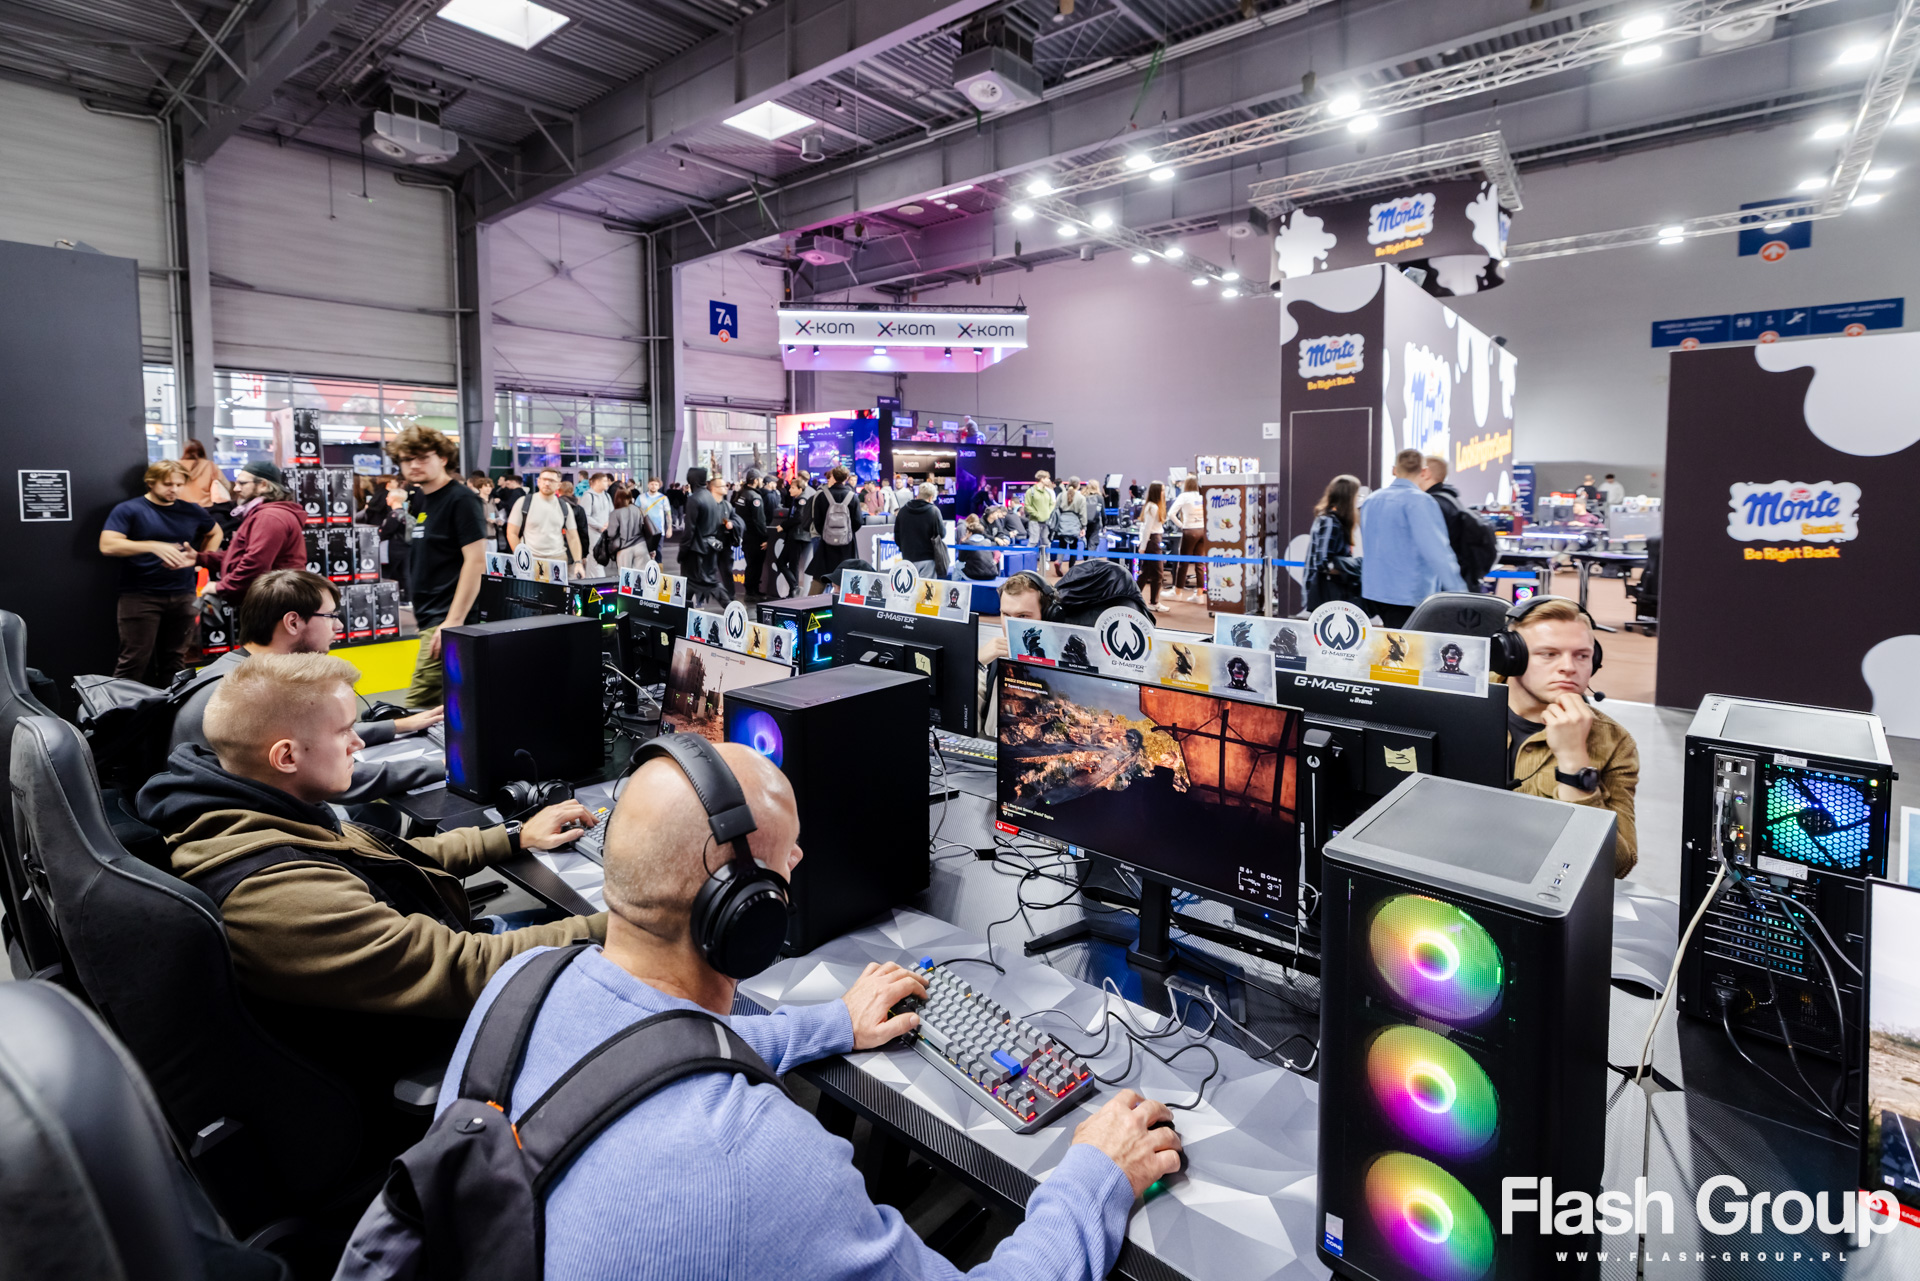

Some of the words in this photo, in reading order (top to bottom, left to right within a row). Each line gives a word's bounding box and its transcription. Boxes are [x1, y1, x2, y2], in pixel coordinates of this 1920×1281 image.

[1377, 201, 1426, 232] Monte
[715, 307, 732, 326] 7A
[1306, 340, 1354, 367] Monte
[1743, 491, 1840, 526] Monte
[1744, 548, 1763, 560] Be
[1763, 547, 1802, 562] Right
[1802, 546, 1841, 559] Back
[1388, 753, 1411, 764] 3
[1267, 883, 1273, 891] 3
